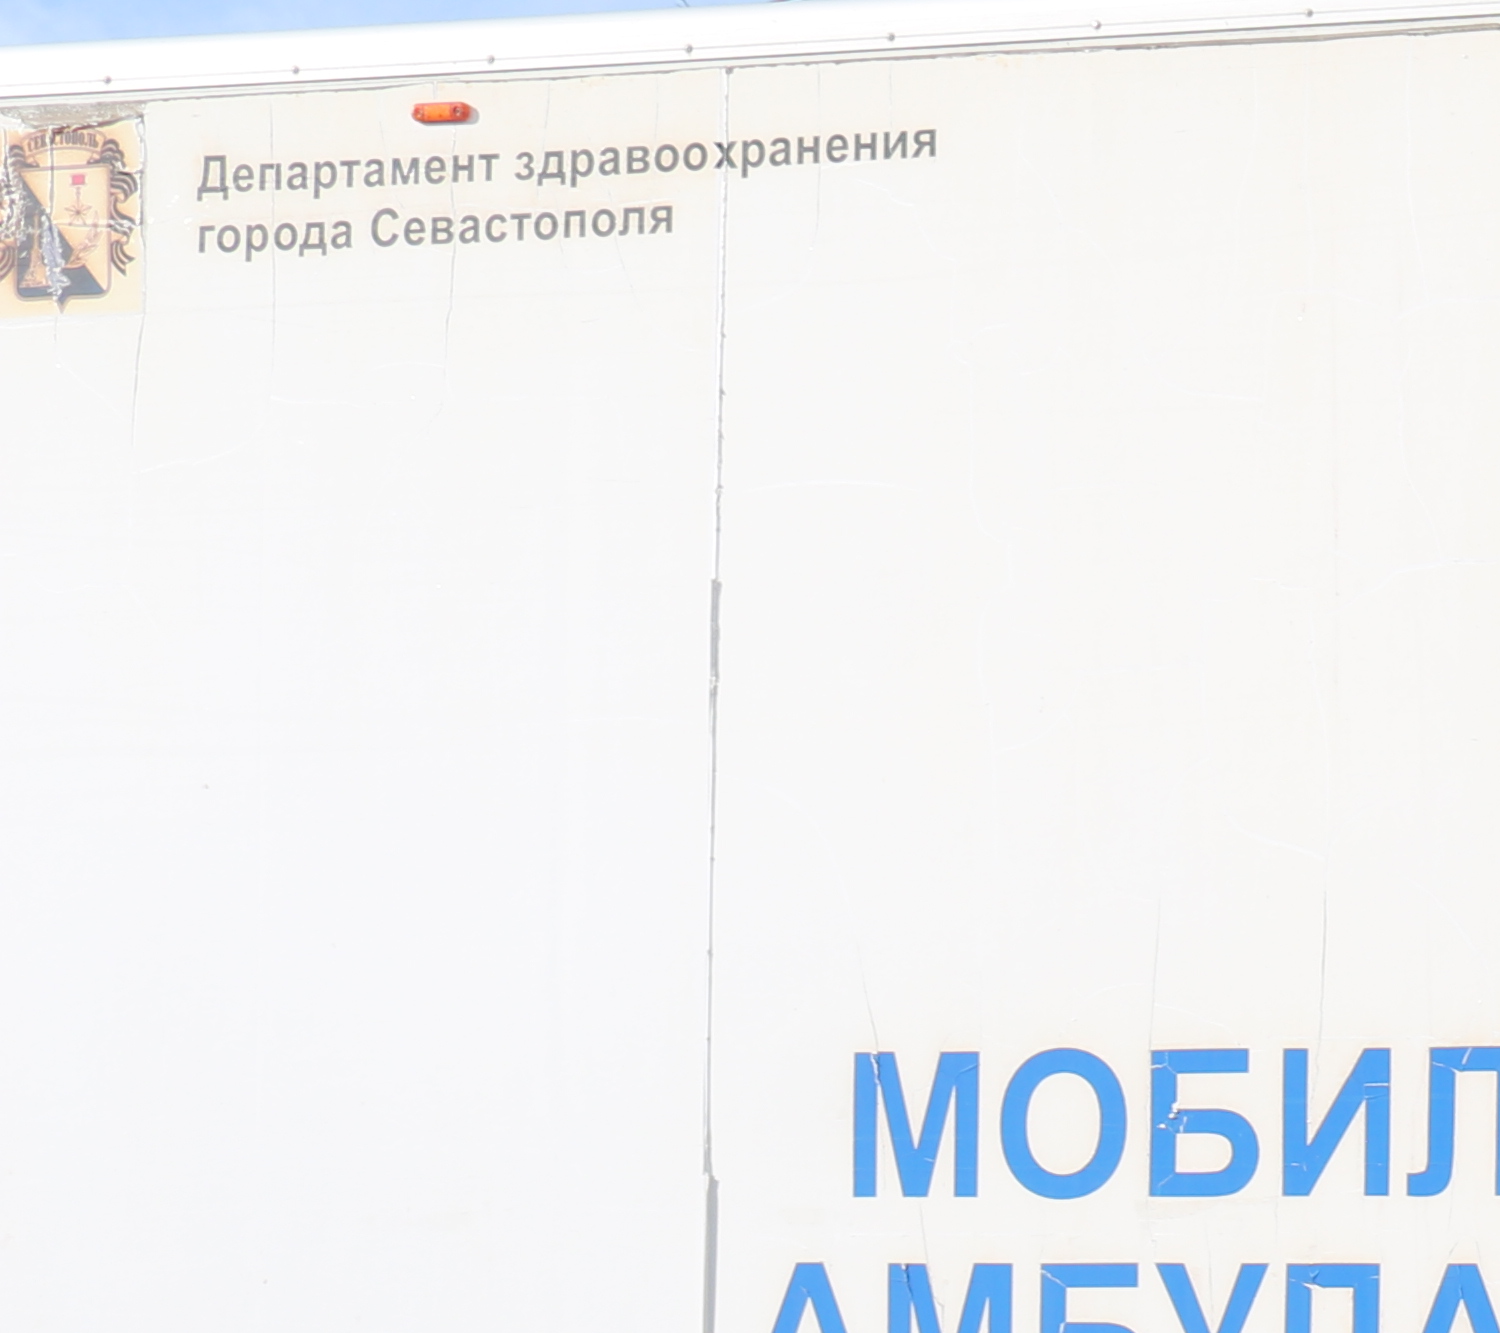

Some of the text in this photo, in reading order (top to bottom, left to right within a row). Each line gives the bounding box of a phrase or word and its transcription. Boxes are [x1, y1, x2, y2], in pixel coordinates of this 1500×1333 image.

[197, 129, 937, 202] Департамент здравоохранения
[199, 205, 673, 262] города Севастополя
